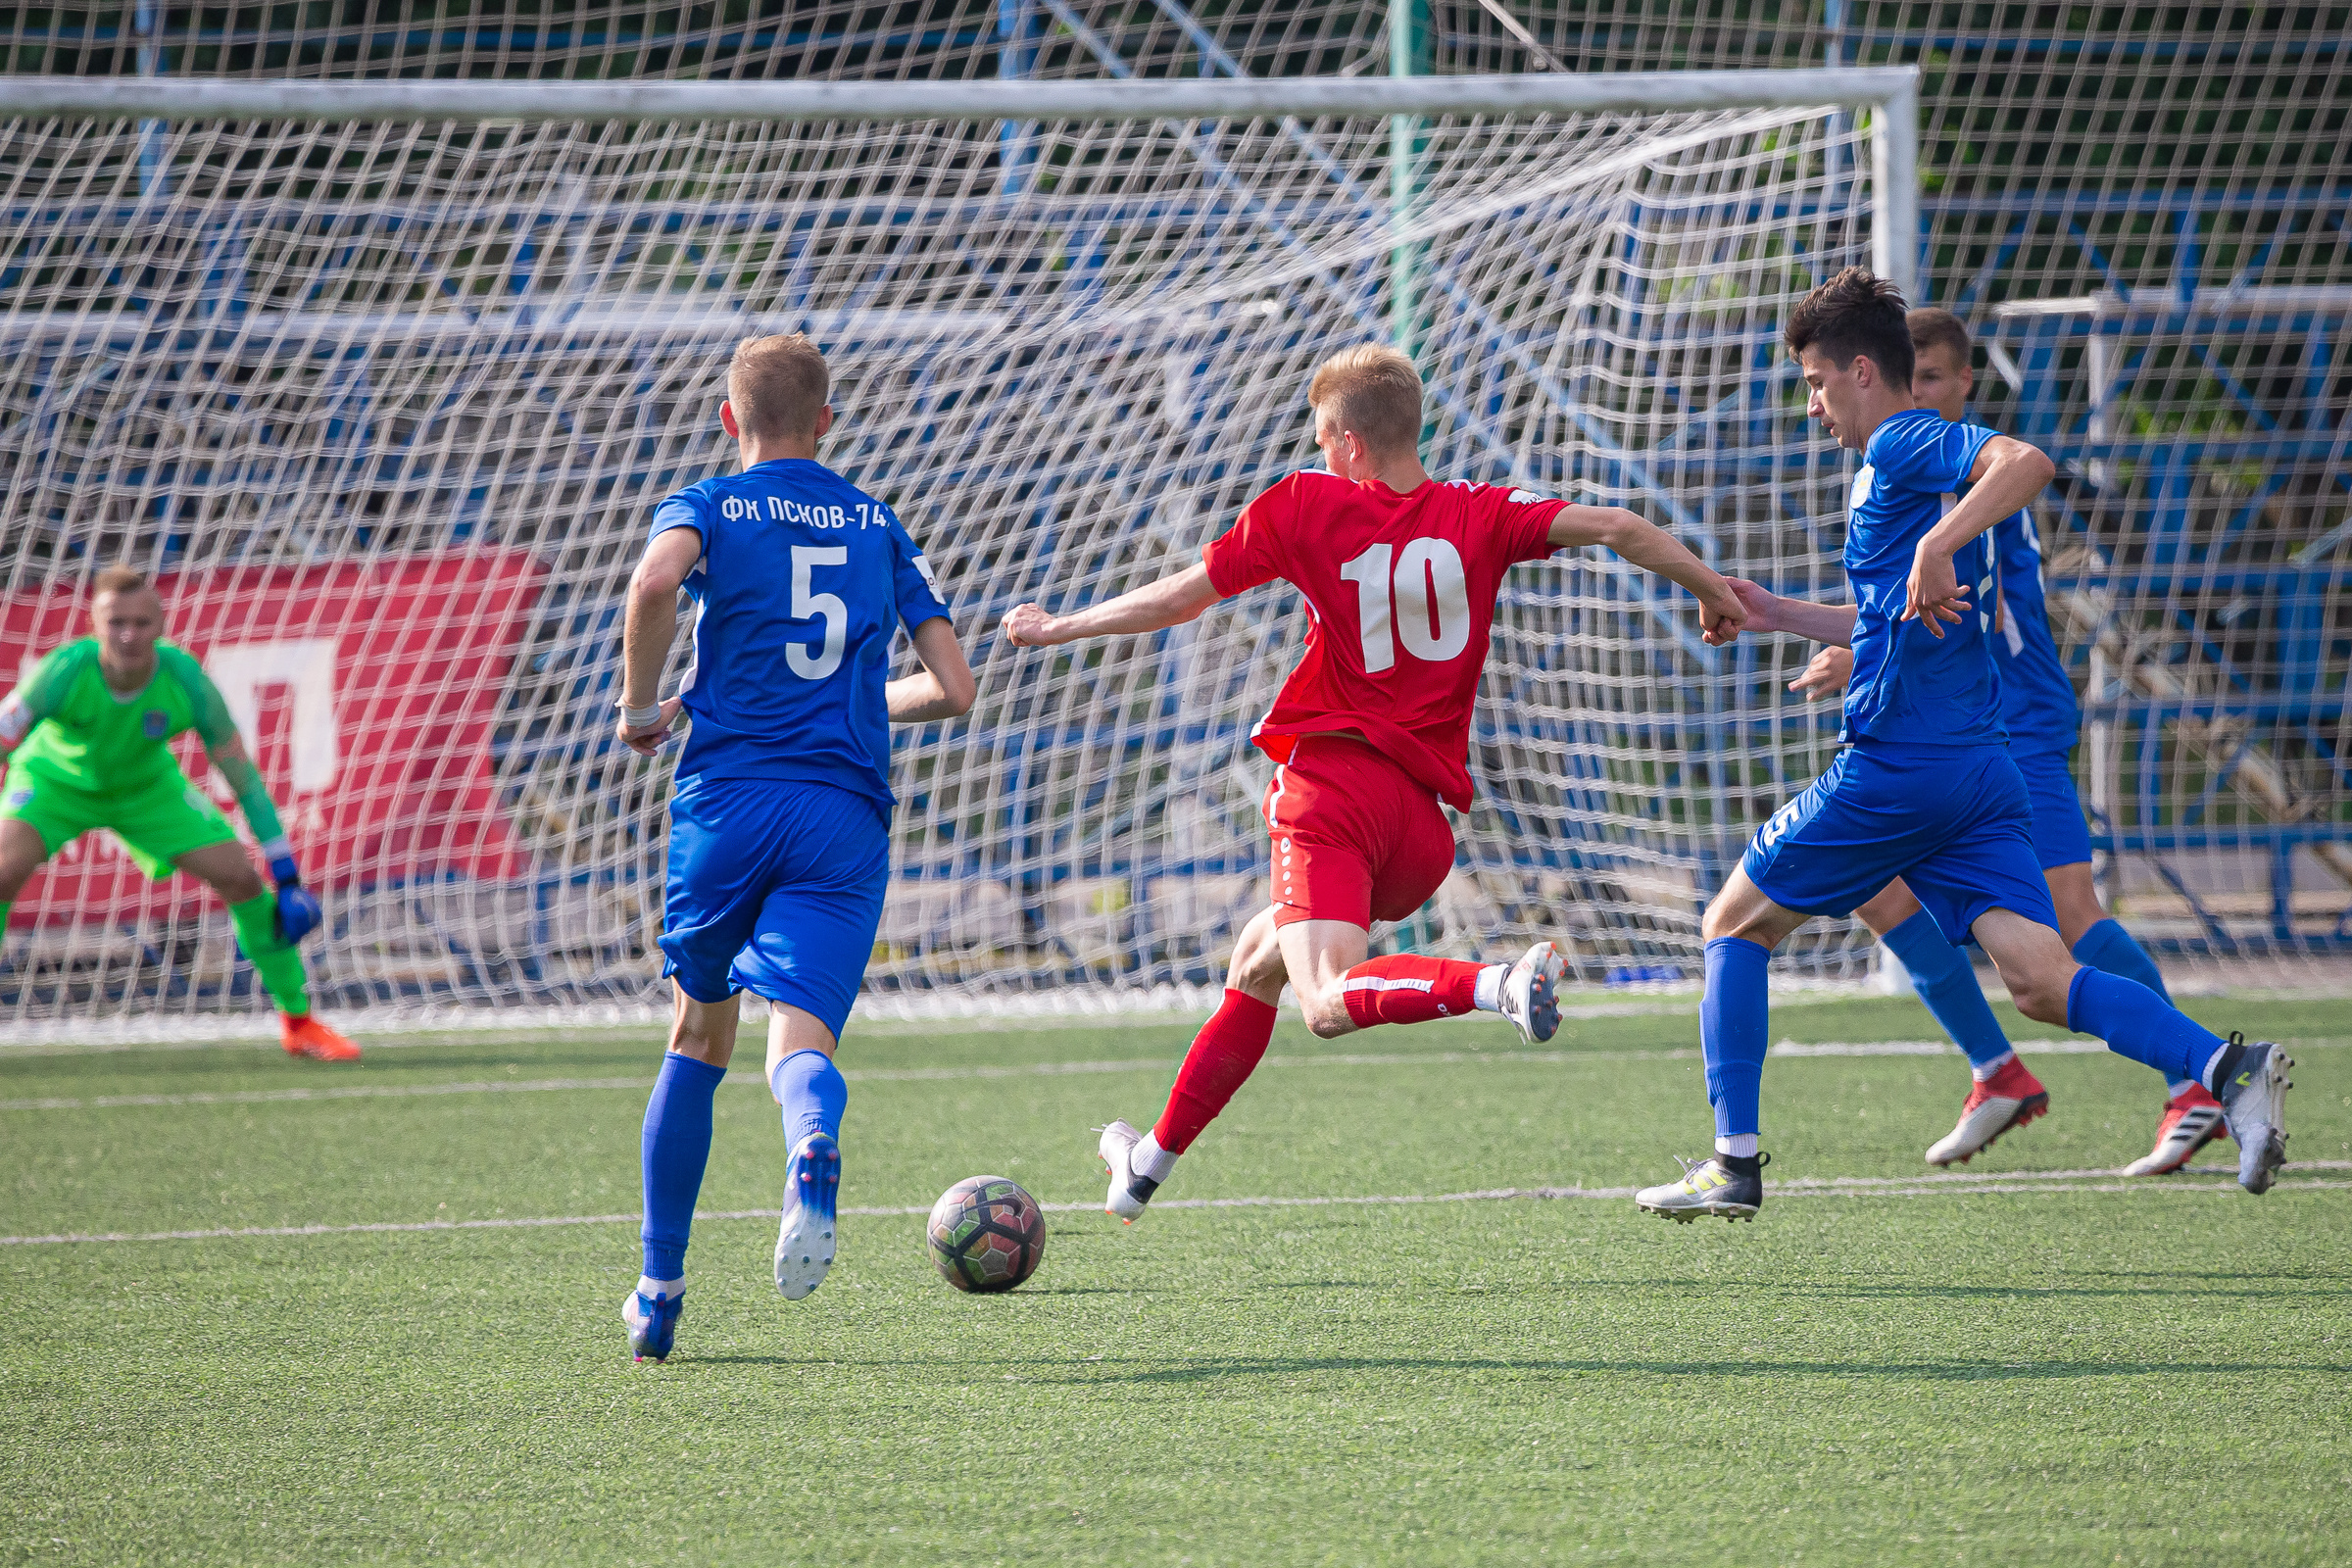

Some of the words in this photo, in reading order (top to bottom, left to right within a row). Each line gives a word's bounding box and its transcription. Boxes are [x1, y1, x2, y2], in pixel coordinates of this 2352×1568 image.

[721, 495, 761, 522] ФК
[766, 496, 891, 530] ПСКОВ-74
[785, 545, 848, 680] 5
[1341, 536, 1470, 673] 10
